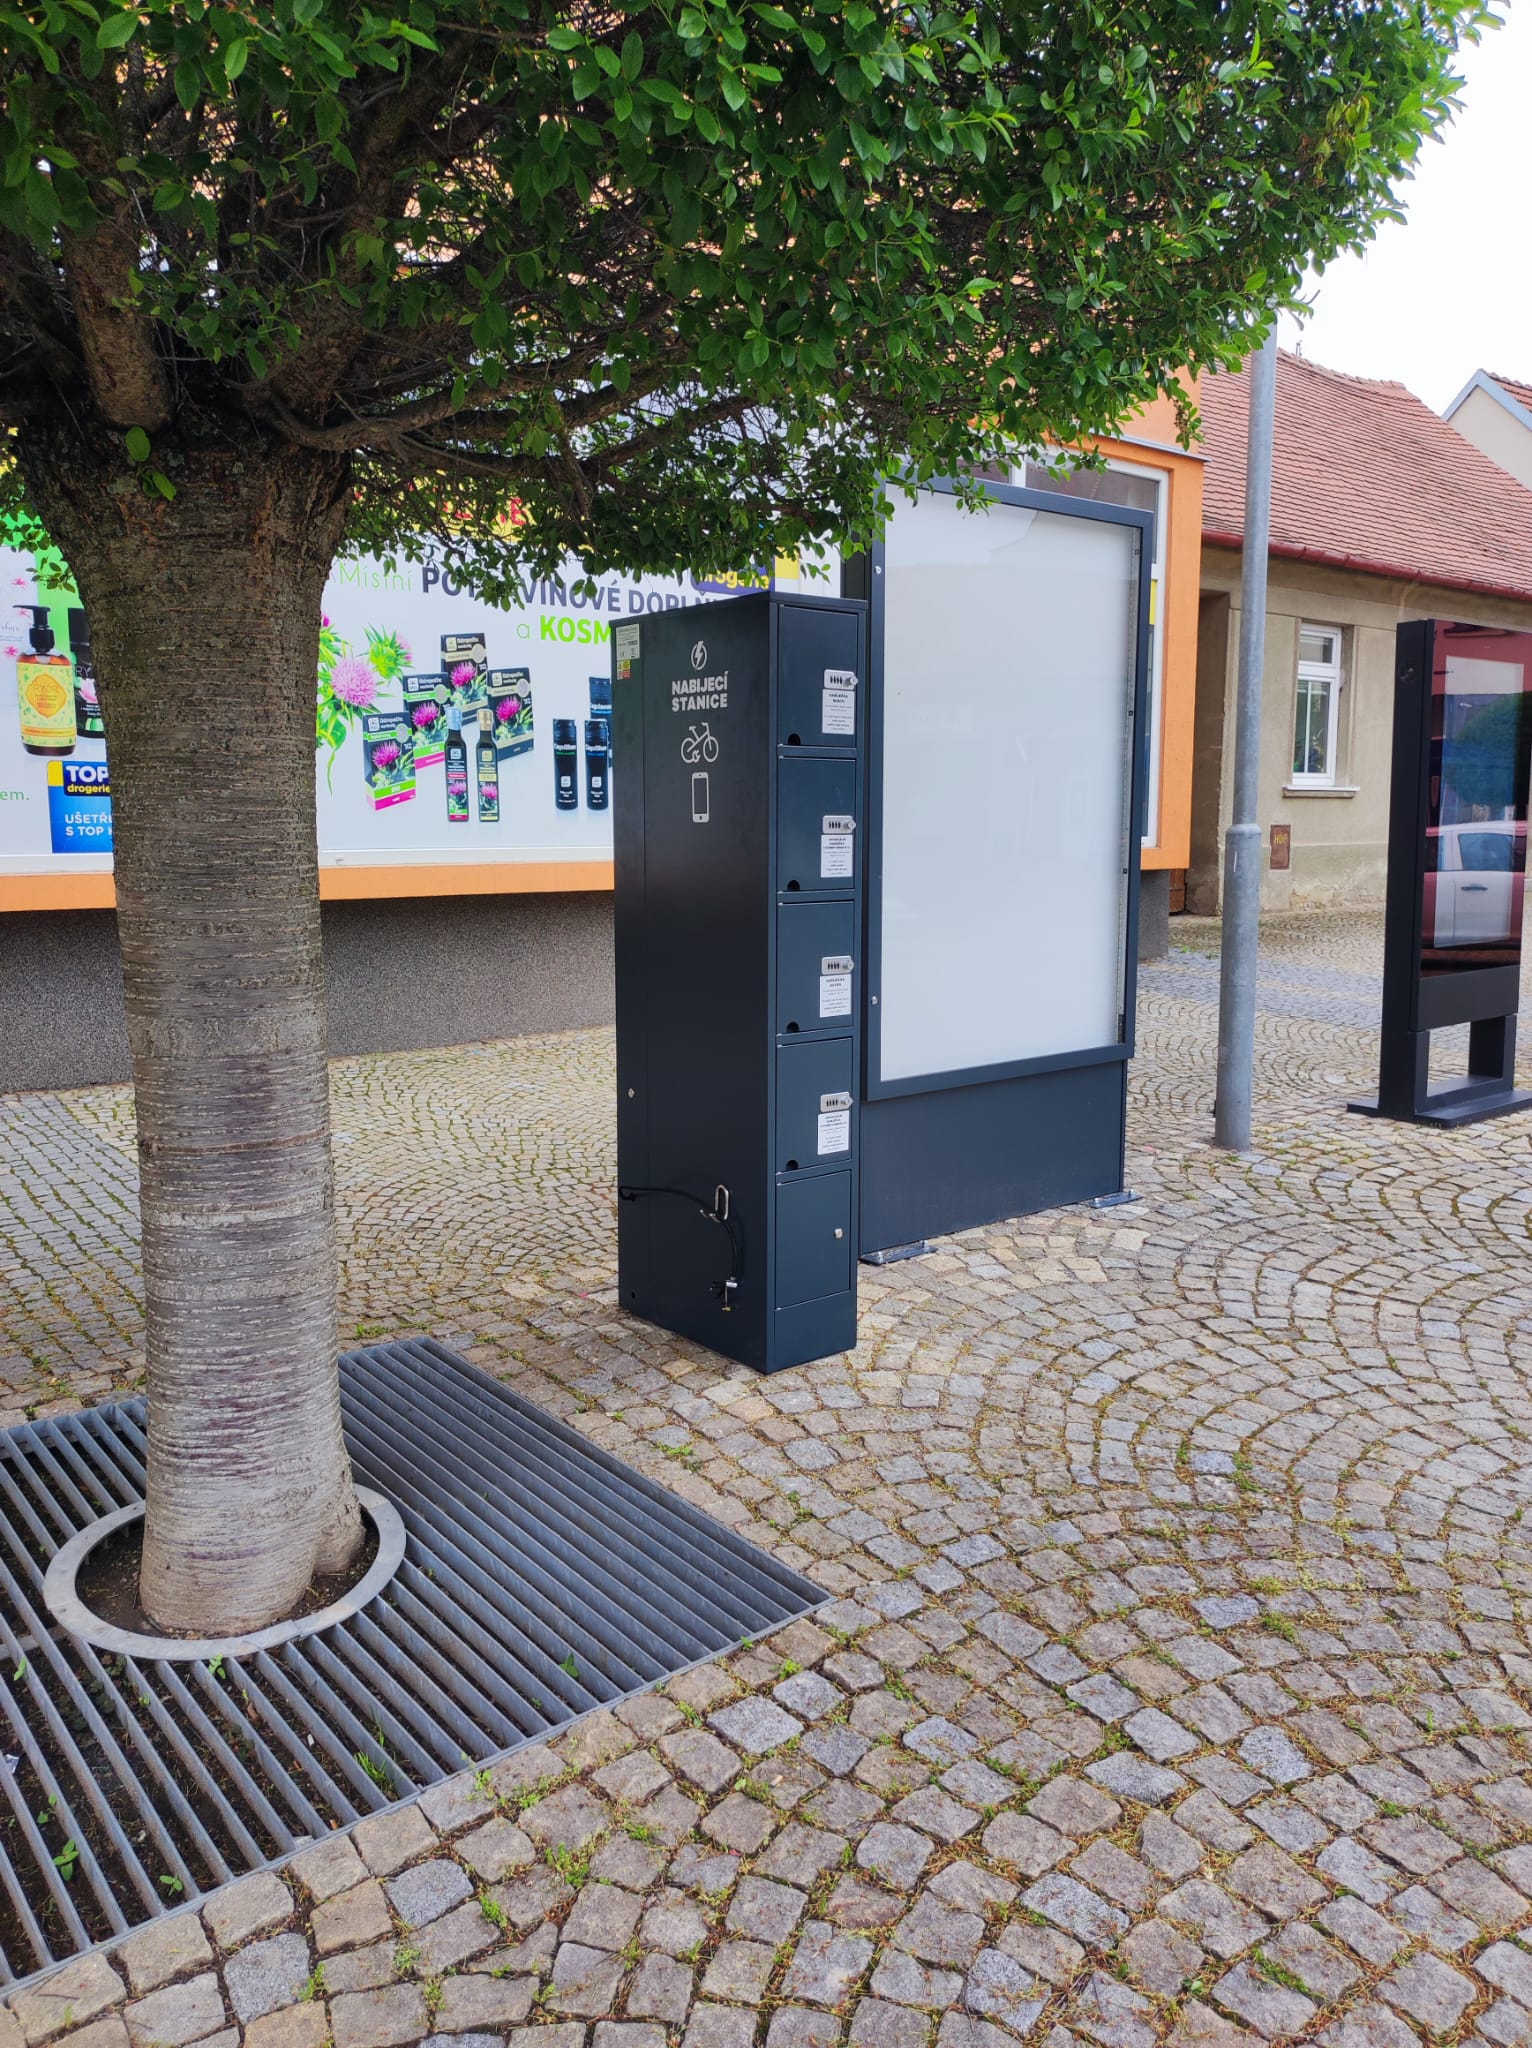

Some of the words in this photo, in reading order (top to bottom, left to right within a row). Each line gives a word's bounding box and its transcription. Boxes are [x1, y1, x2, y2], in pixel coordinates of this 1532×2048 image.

[516, 623, 530, 640] a
[671, 671, 729, 696] NABIJECÍ
[671, 693, 728, 712] STANICE
[66, 765, 108, 782] TOP
[67, 783, 111, 794] drogerie
[65, 826, 74, 836] S
[77, 826, 104, 836] TOP
